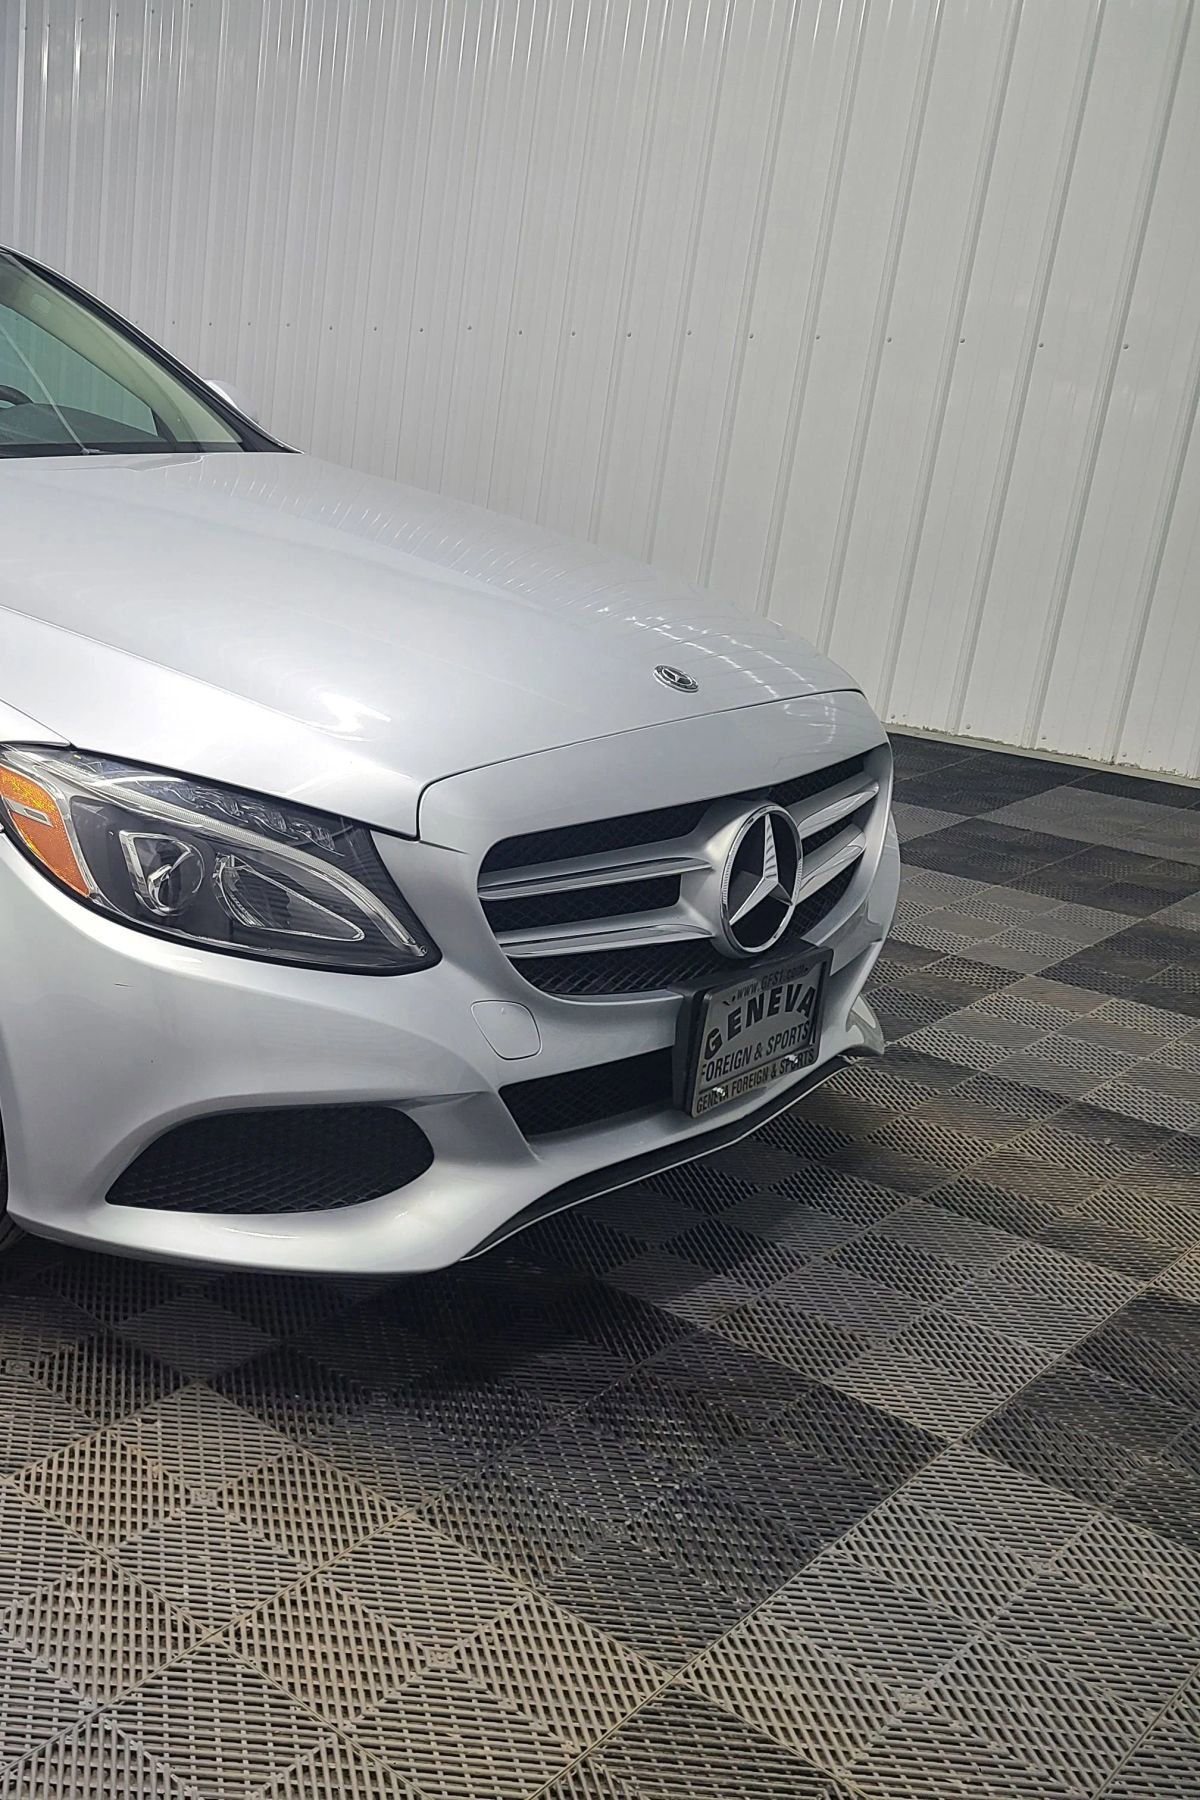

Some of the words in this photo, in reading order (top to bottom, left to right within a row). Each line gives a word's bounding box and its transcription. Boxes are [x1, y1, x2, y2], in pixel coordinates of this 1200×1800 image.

[704, 984, 816, 1060] GENEVA
[754, 1043, 764, 1060] &
[766, 1021, 810, 1056] SPORTS
[731, 1066, 769, 1096] FOREIGN
[771, 1064, 778, 1078] &
